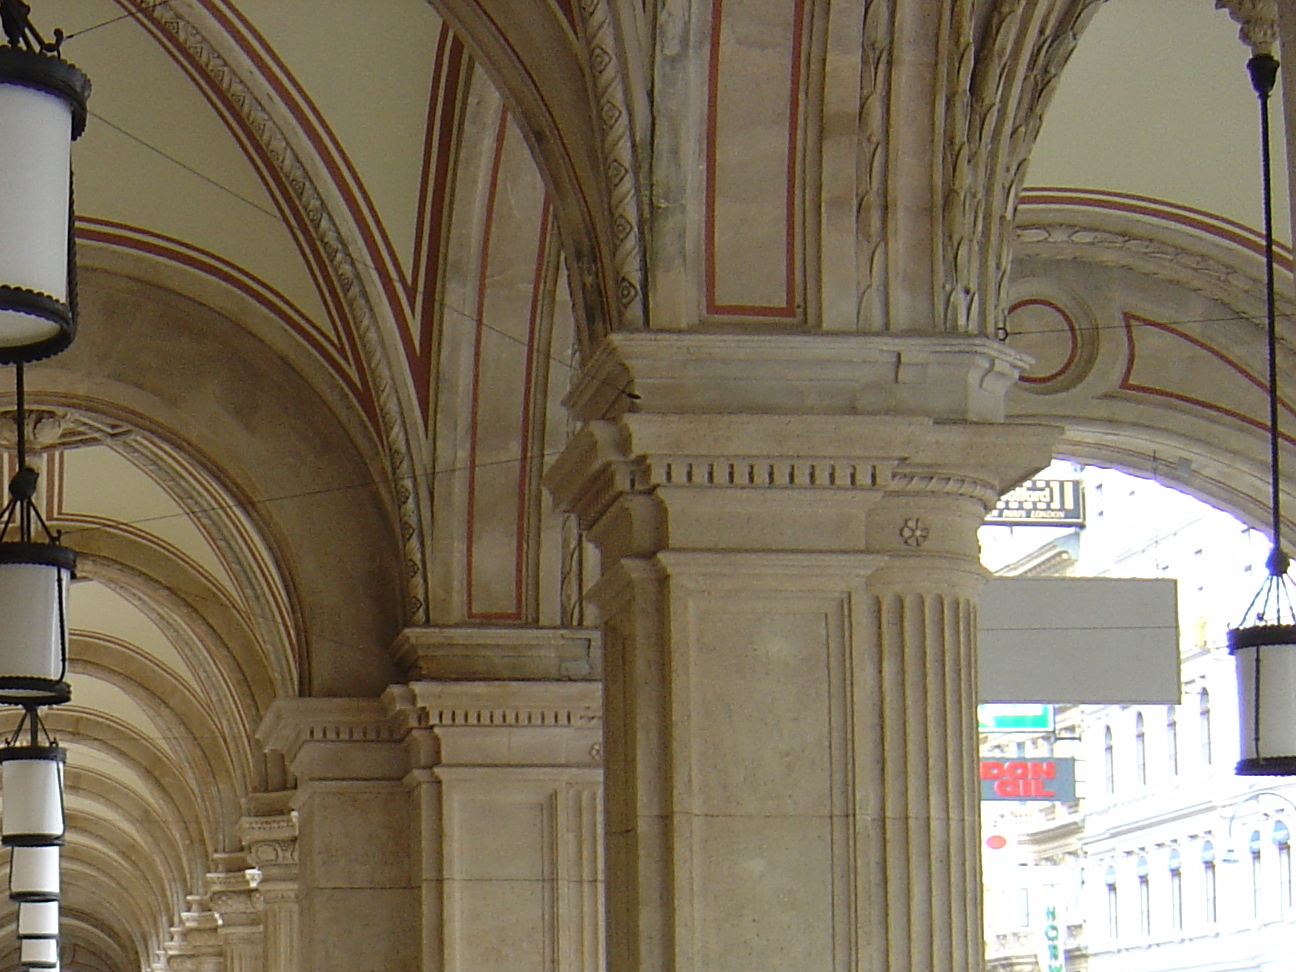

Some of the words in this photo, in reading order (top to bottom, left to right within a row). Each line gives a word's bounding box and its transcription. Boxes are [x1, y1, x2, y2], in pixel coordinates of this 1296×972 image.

[1000, 486, 1050, 502] olford
[1031, 510, 1065, 518] LONDON
[979, 761, 1056, 780] DON
[994, 778, 1056, 797] GIL
